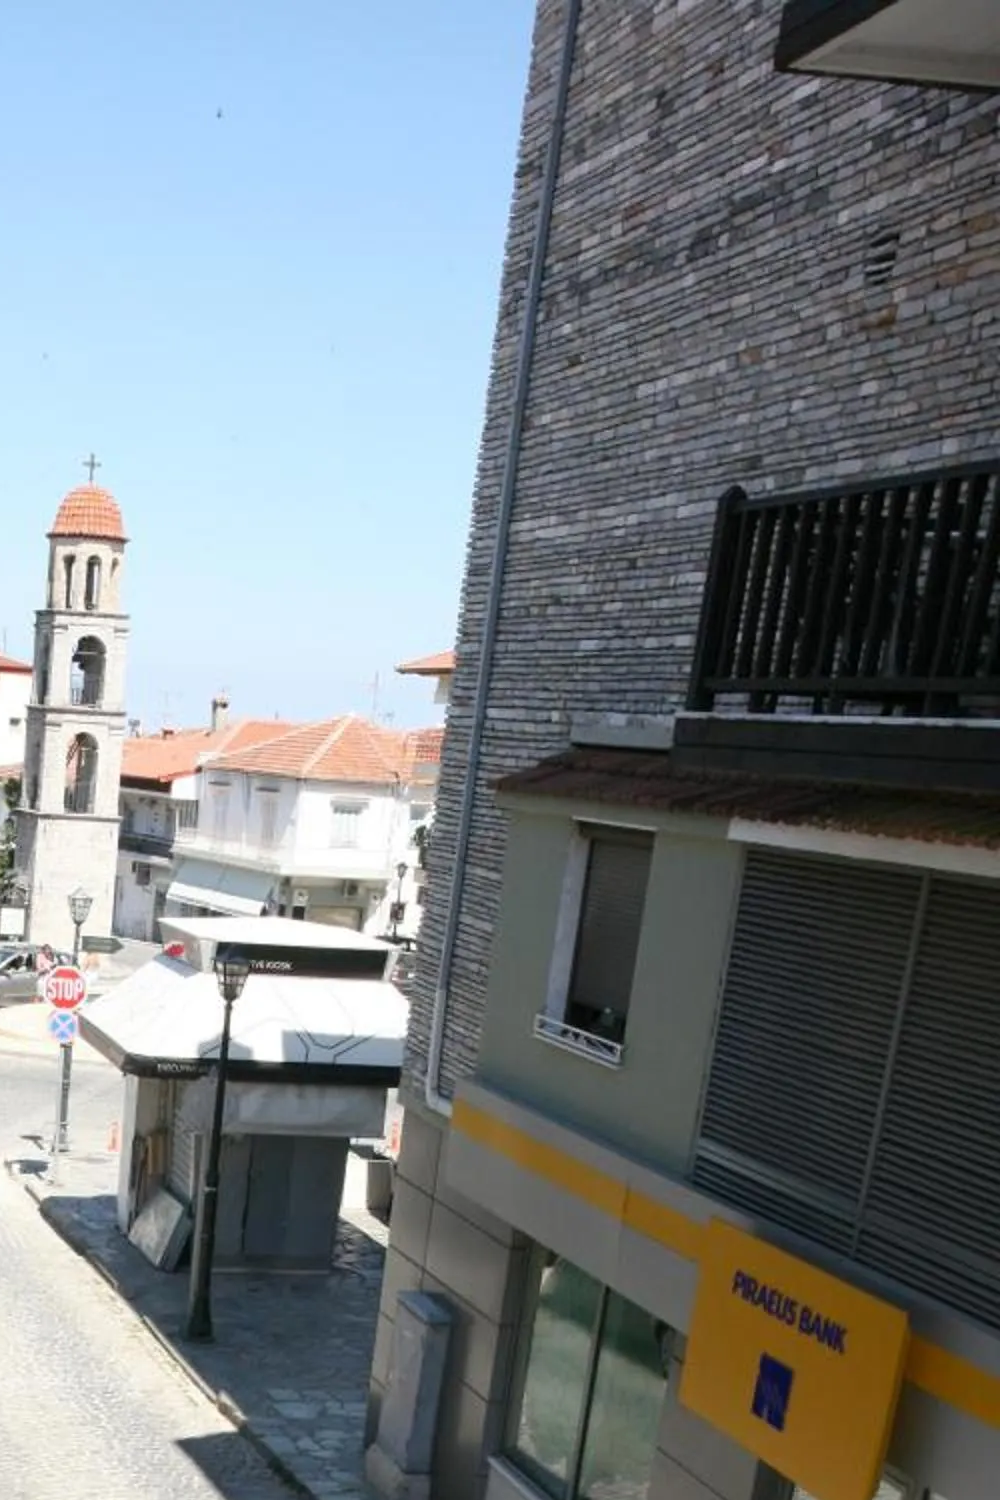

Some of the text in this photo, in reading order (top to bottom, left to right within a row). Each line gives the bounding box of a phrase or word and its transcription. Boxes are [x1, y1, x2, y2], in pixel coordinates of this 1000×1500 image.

[47, 977, 83, 1001] STOP
[732, 1269, 848, 1355] PIRAEUS BANK
